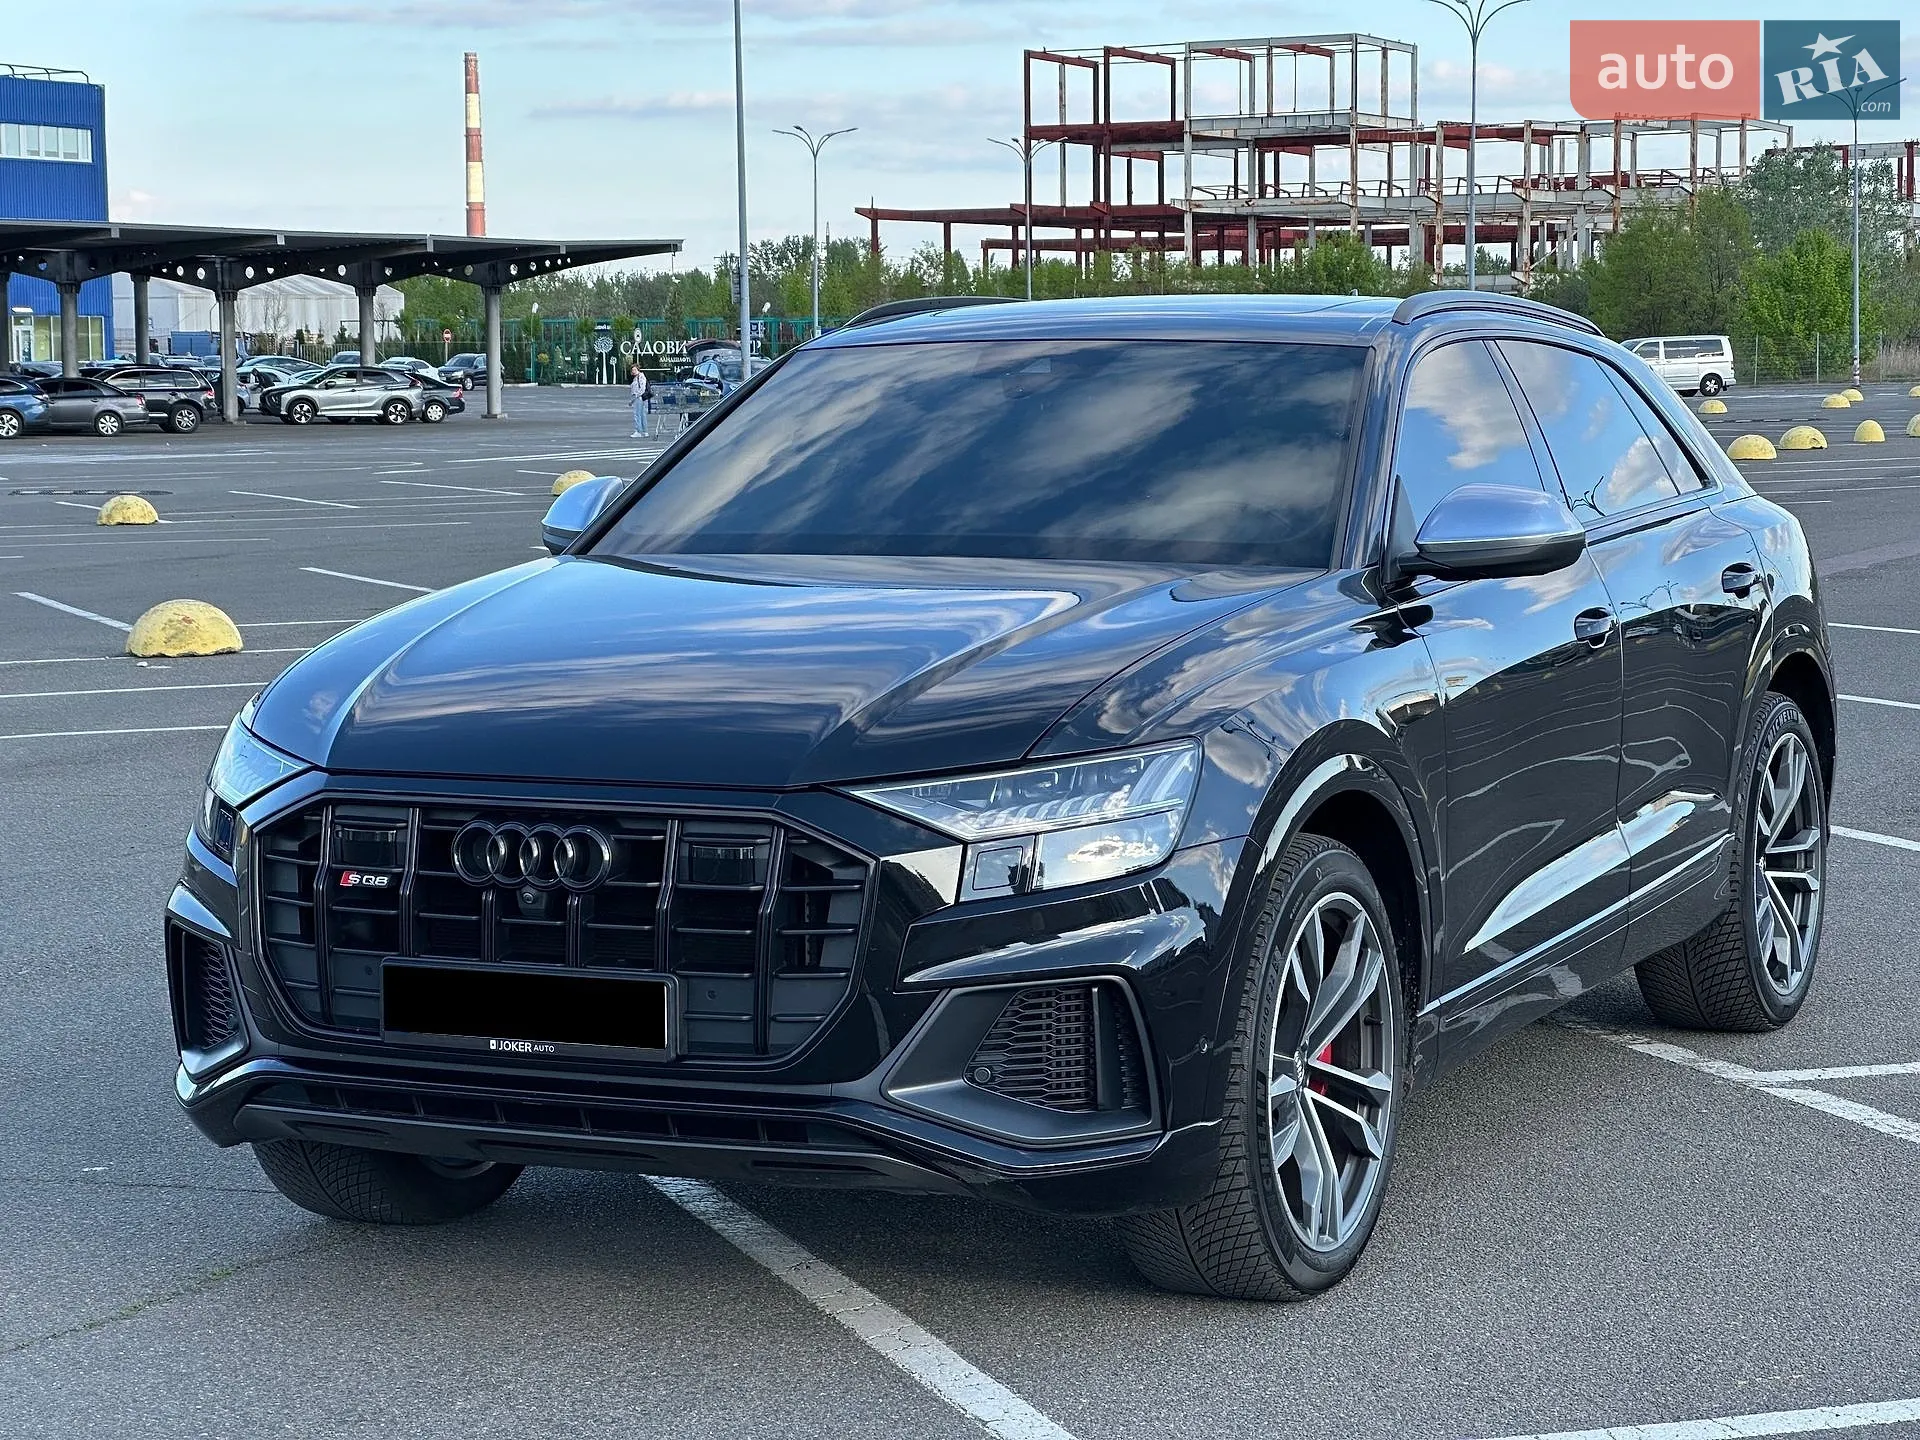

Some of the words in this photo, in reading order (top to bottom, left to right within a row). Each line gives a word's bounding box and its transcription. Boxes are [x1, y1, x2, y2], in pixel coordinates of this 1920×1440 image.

[620, 337, 697, 356] САДОВИ
[348, 874, 388, 886] SQ8
[499, 1040, 532, 1052] JOKER
[533, 1044, 555, 1052] AUTO
